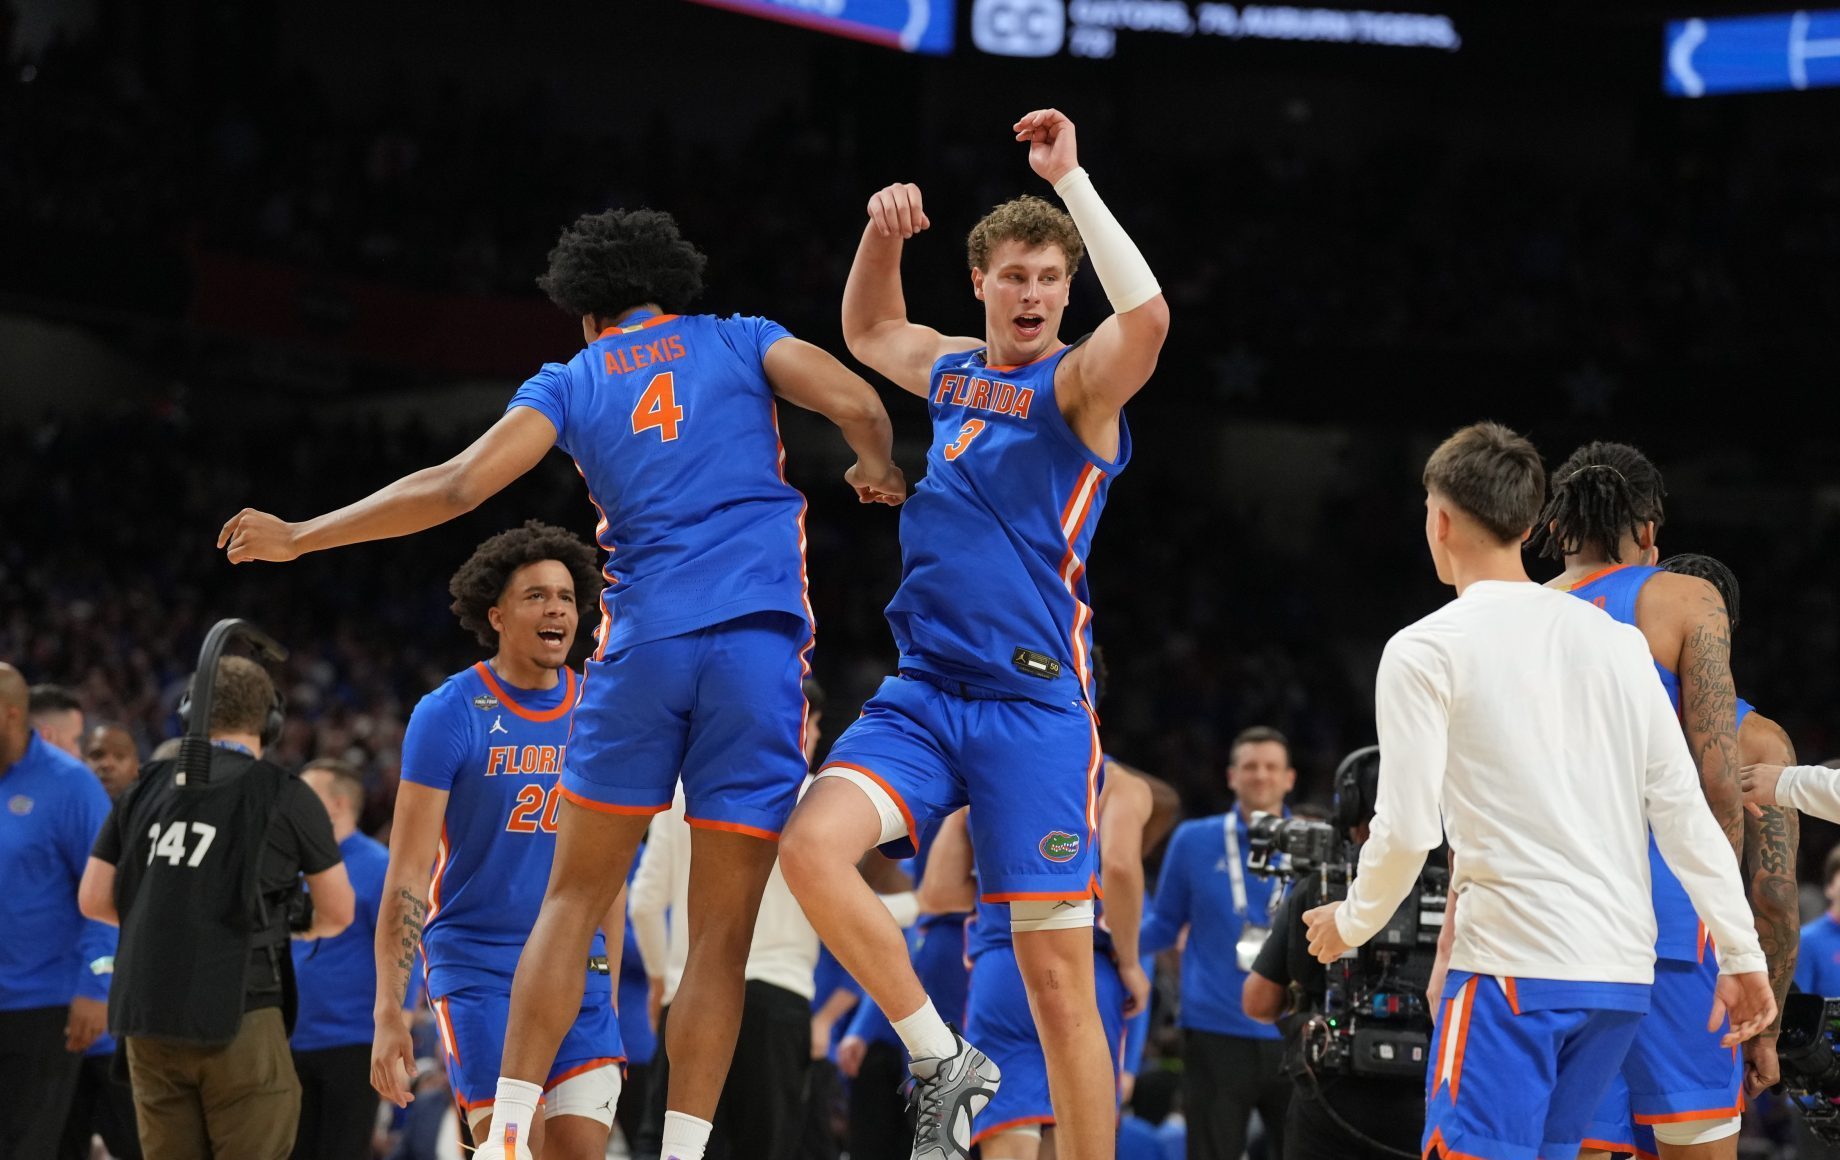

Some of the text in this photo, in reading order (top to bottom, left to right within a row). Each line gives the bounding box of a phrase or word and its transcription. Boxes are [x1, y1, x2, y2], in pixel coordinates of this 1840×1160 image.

[604, 335, 686, 375] ALEXIS
[631, 371, 683, 443] 4
[934, 374, 1035, 419] FLORIDA
[944, 418, 986, 461] 3
[506, 784, 560, 833] 20
